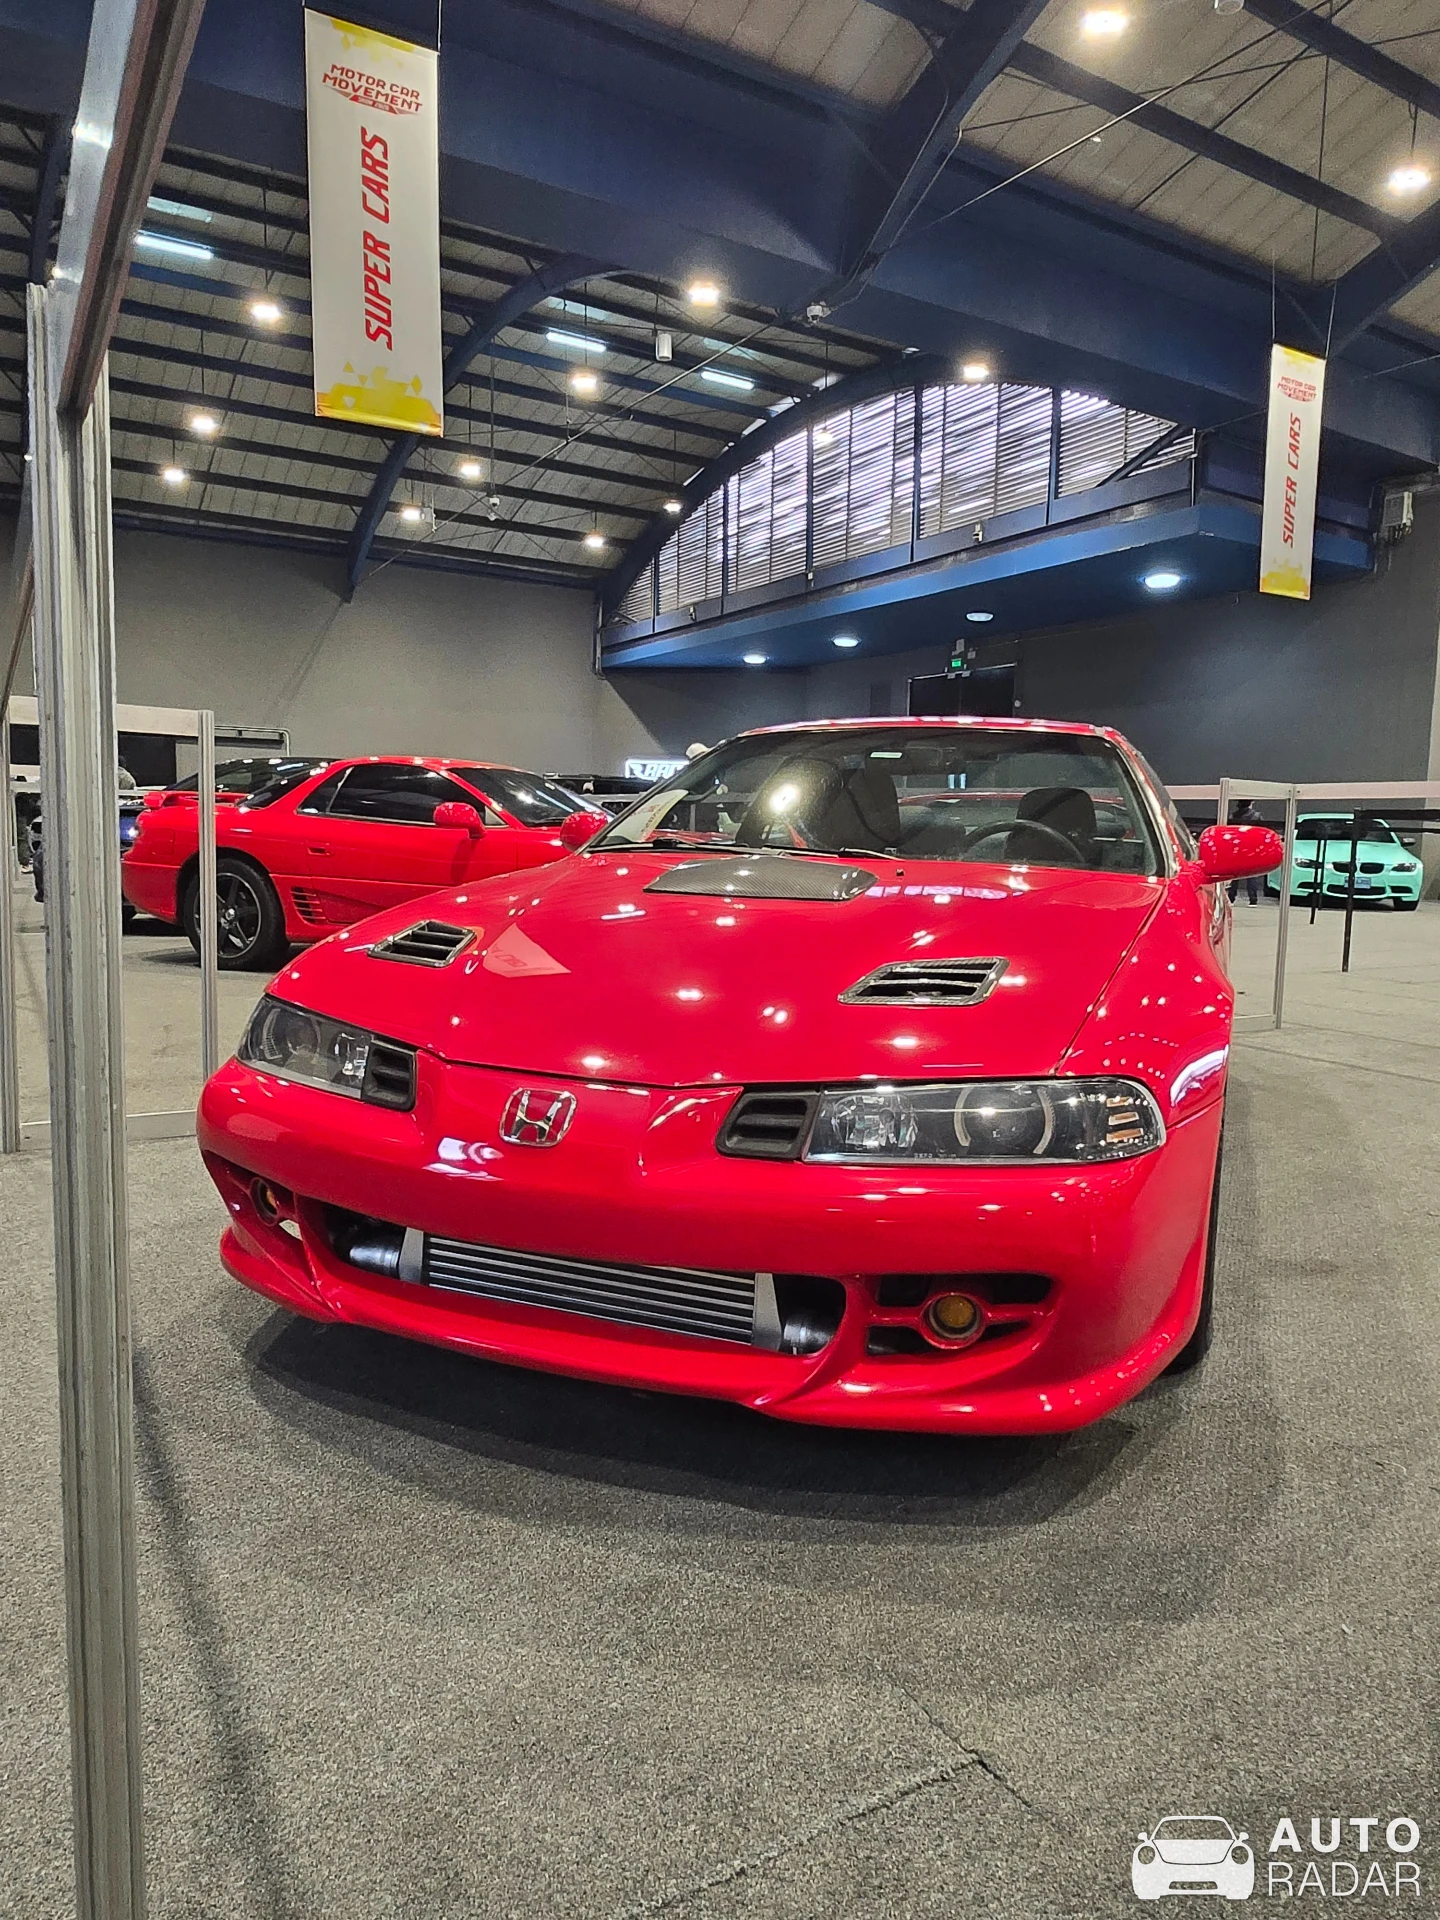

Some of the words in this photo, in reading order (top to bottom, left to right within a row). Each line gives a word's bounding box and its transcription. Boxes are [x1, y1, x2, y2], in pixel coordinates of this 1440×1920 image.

[322, 72, 423, 112] MOVEMENT
[330, 63, 387, 90] MOTOR
[389, 83, 421, 101] CAR
[360, 125, 389, 224] CARS
[363, 230, 393, 351] SUPER
[1277, 382, 1318, 399] MOVEMENT
[1287, 412, 1301, 470] CARS
[1282, 475, 1298, 549] SUPER
